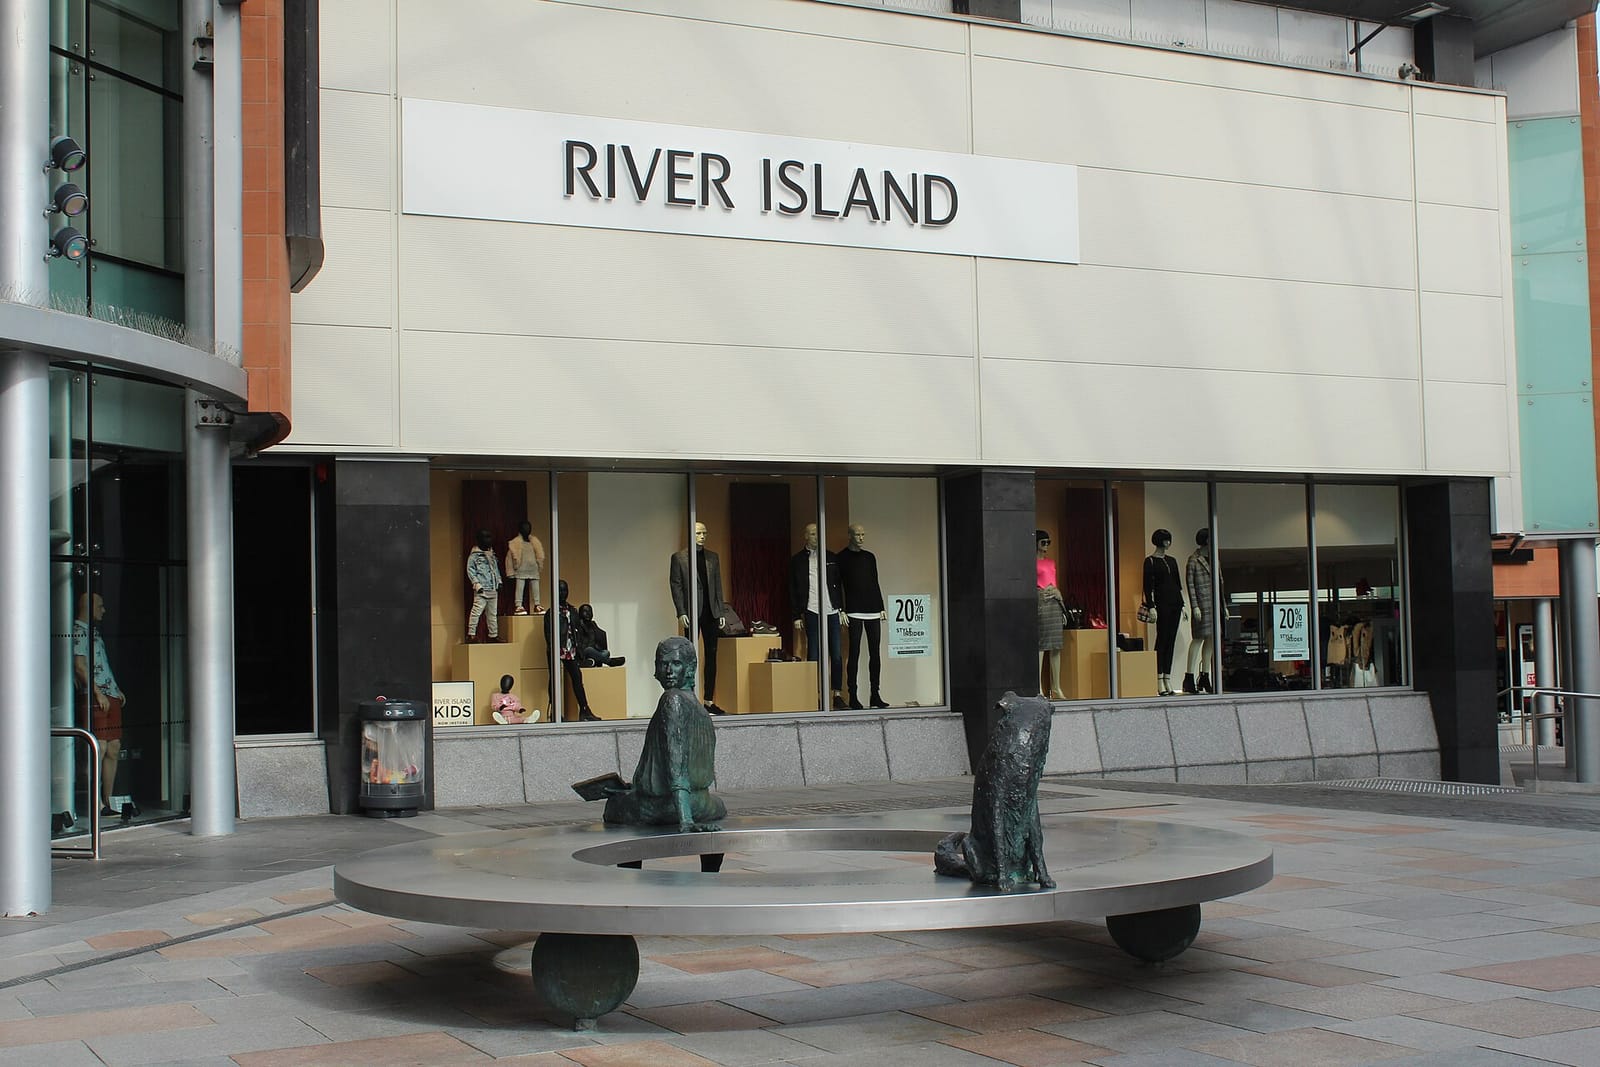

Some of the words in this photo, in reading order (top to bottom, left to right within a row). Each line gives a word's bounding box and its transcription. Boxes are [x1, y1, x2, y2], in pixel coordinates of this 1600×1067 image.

[563, 139, 736, 210] RIVER
[760, 157, 959, 228] ISLAND
[895, 598, 924, 622] 20%
[914, 614, 924, 622] OFF
[1279, 607, 1302, 629] 20%
[434, 705, 472, 718] KIDS
